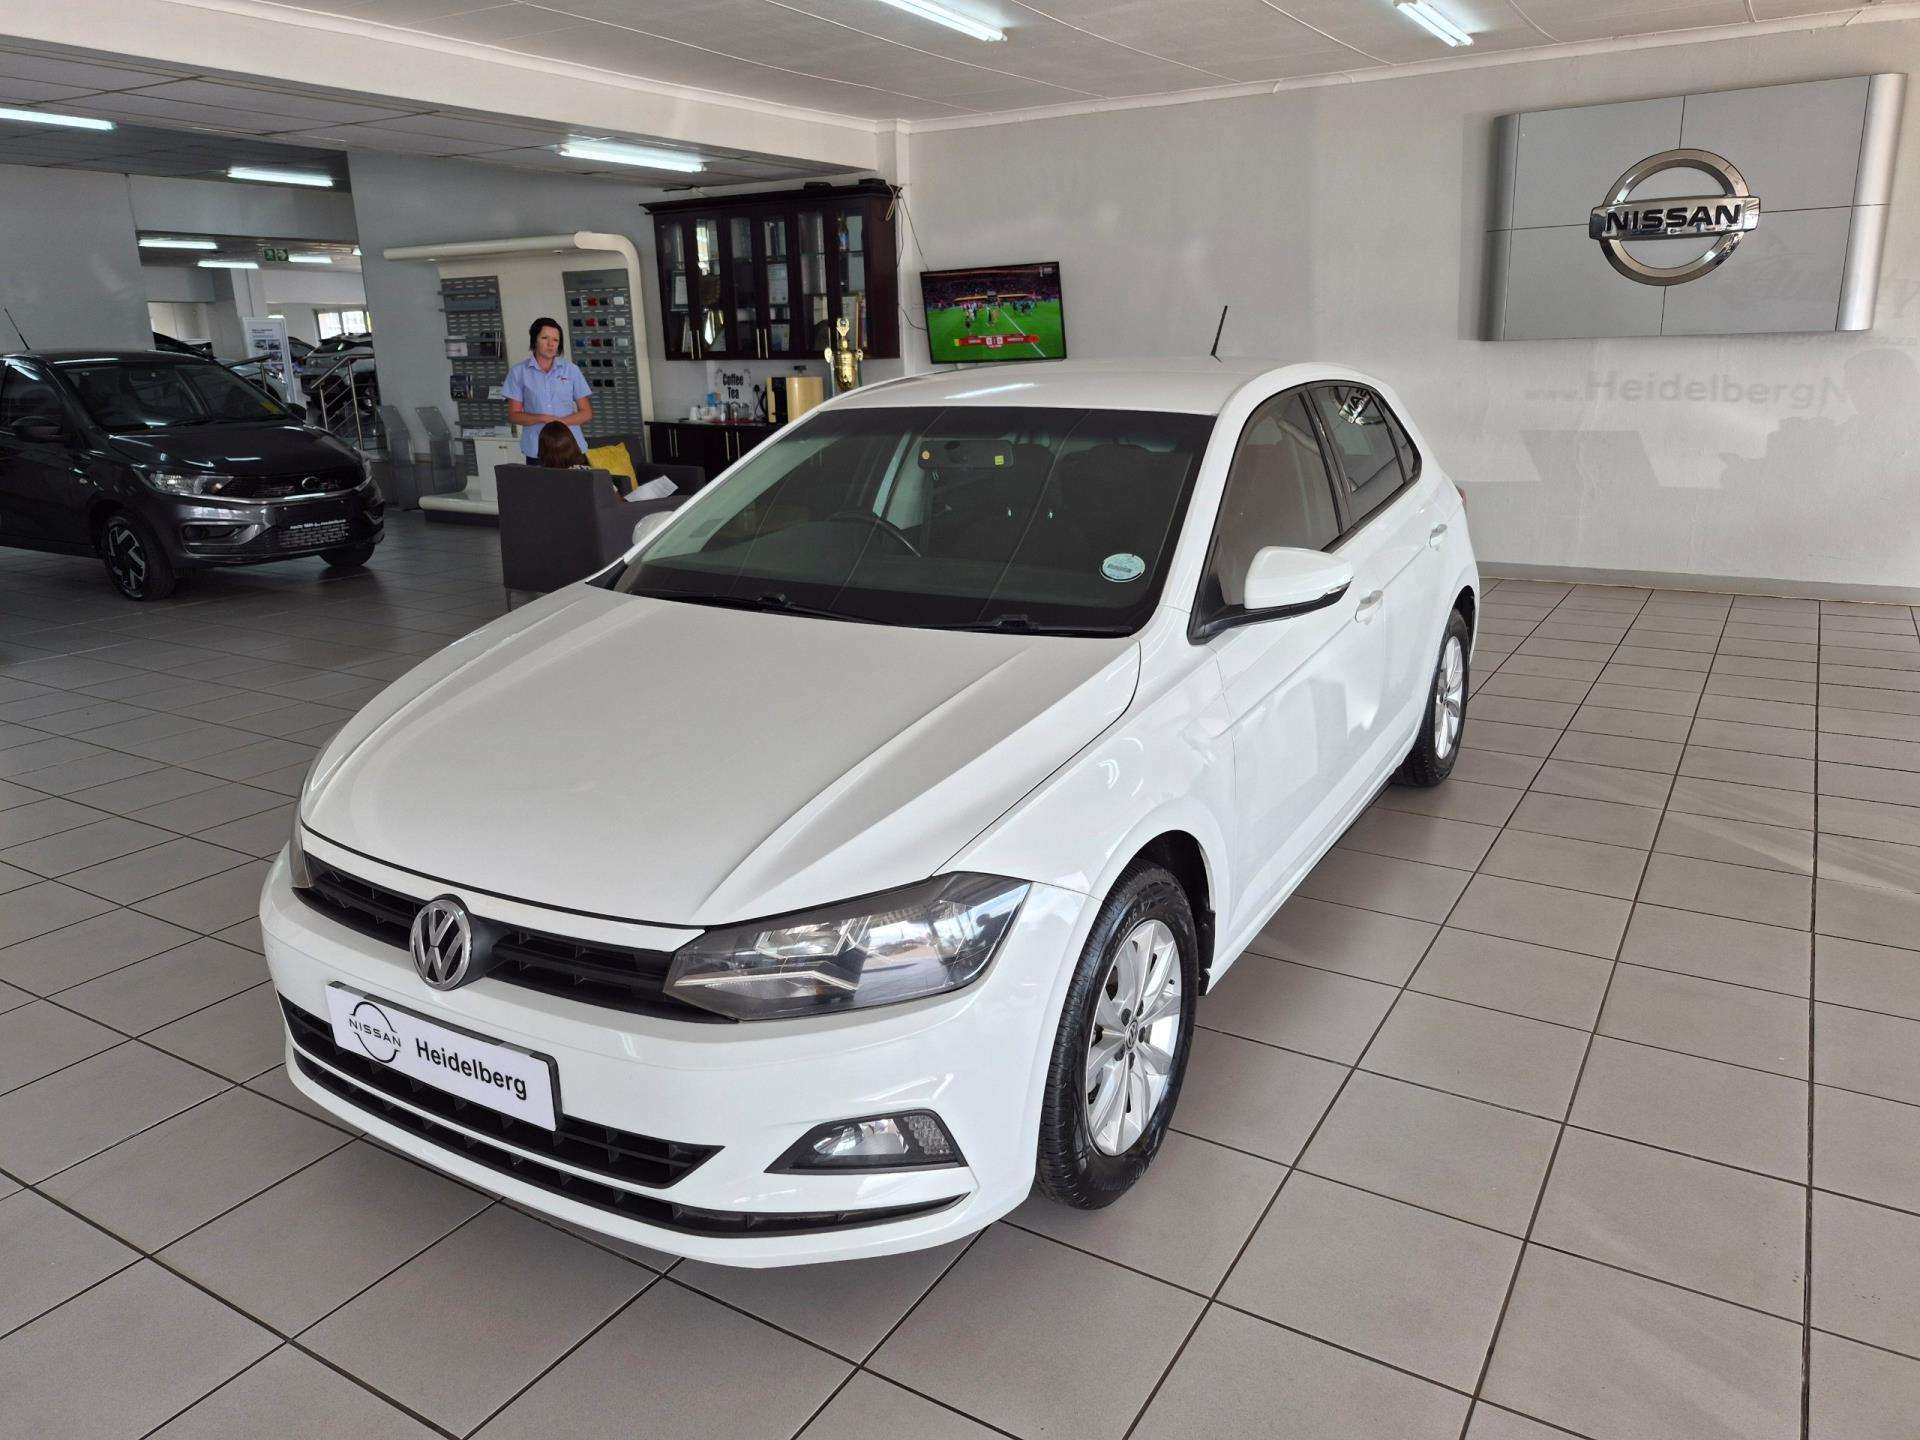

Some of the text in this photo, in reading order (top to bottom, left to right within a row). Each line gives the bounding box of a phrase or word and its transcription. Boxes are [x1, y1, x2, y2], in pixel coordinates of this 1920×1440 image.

[1606, 204, 1741, 232] NISSAN
[722, 373, 744, 386] Coffee
[728, 386, 740, 399] Tea
[349, 1018, 401, 1048] NISSAN
[415, 1037, 528, 1101] Heidelberg
